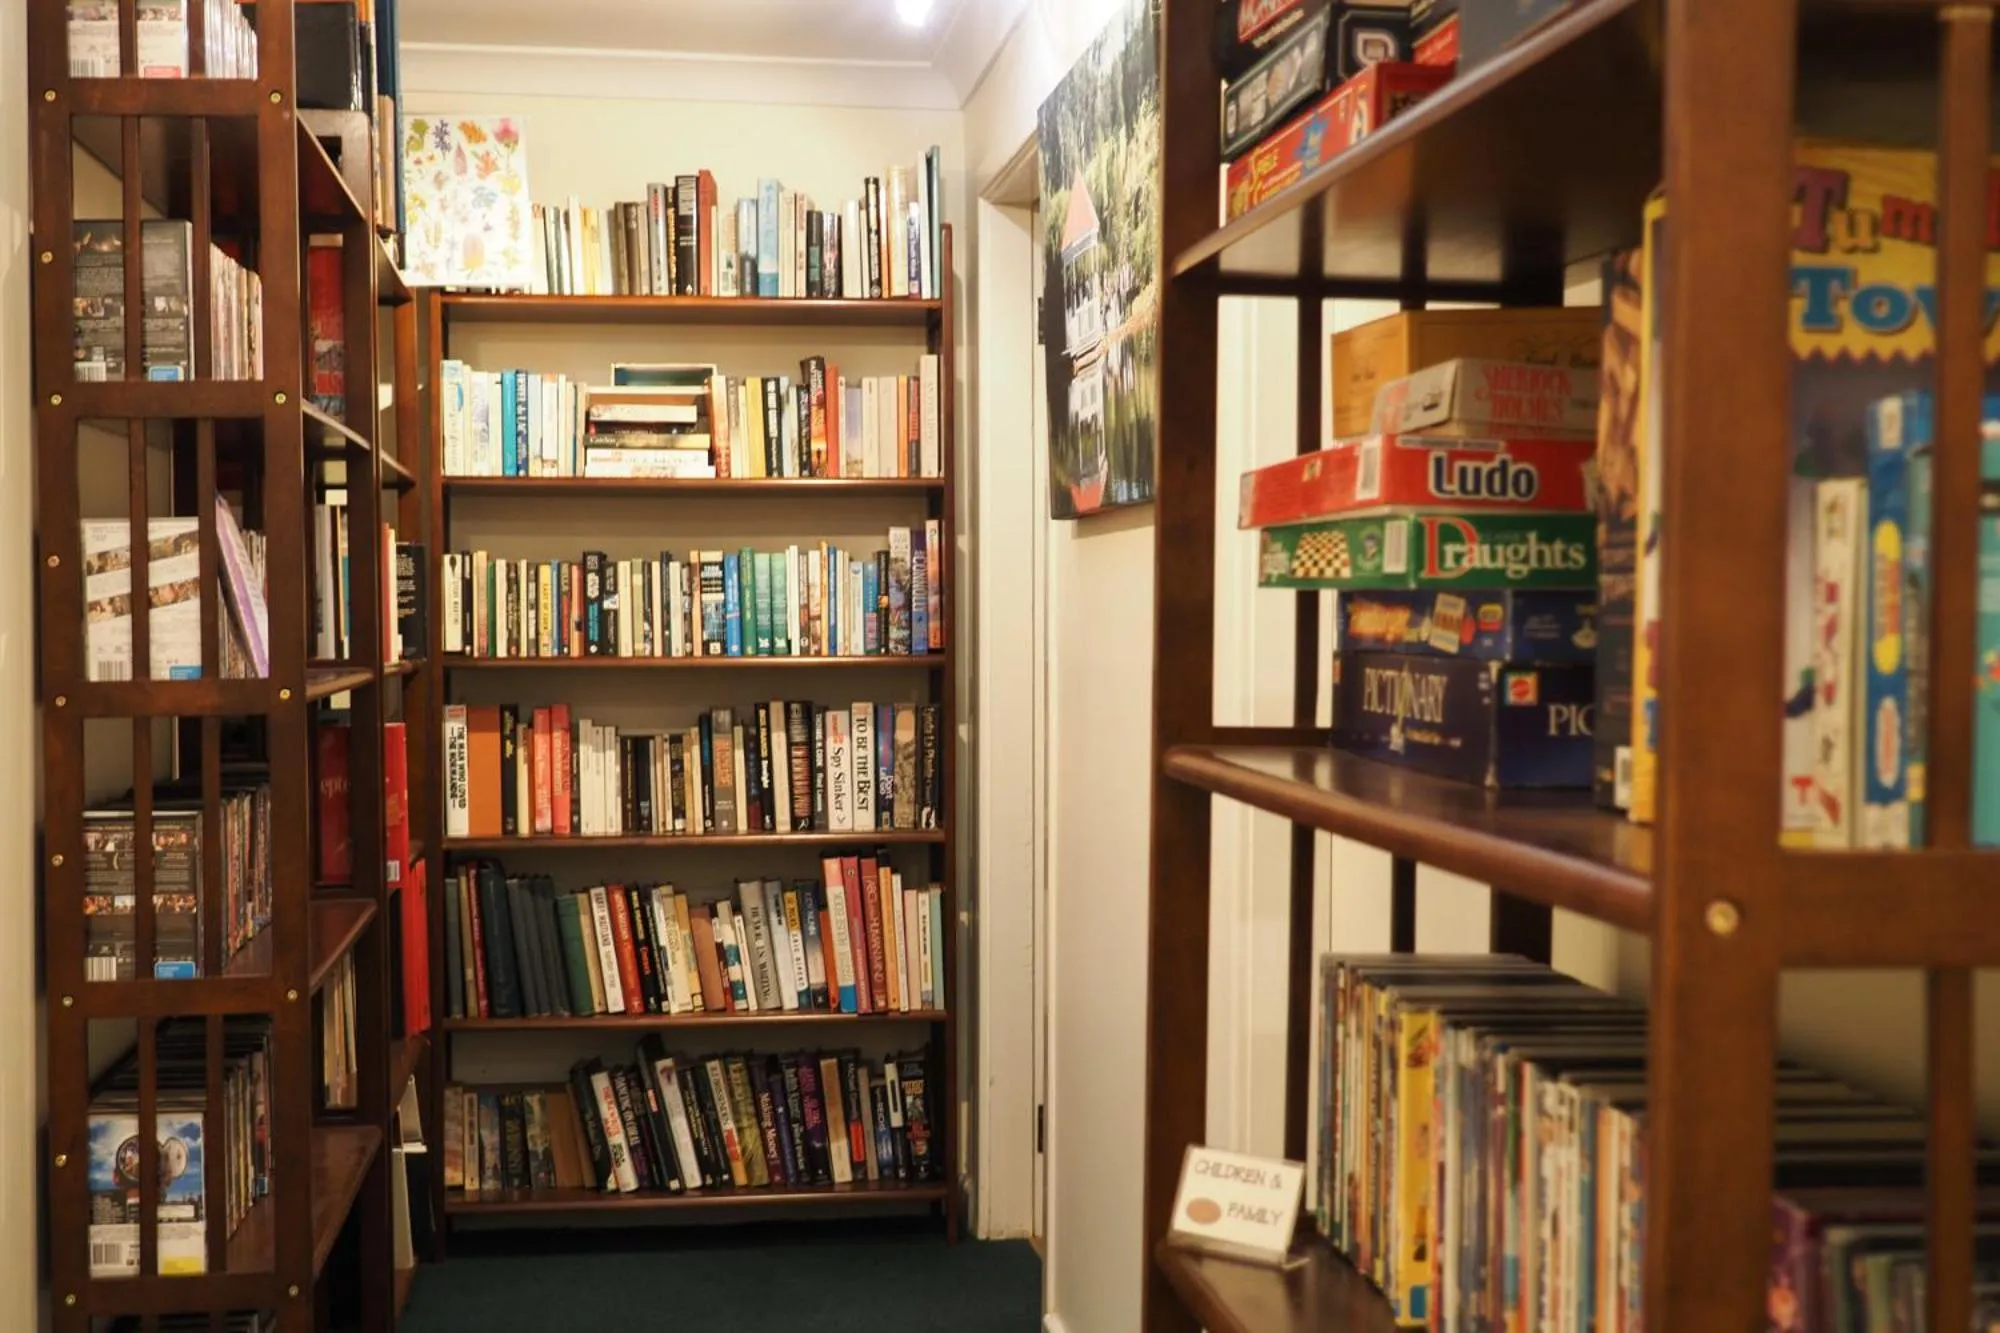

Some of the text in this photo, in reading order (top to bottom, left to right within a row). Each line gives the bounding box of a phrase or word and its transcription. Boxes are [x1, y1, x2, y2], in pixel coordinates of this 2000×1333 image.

[1428, 452, 1538, 502] Ludo
[1417, 517, 1587, 581] Draughts
[912, 555, 927, 612] CONNOLLY
[1362, 667, 1449, 723] PICTIONARY
[855, 716, 870, 733] TO
[458, 743, 466, 762] MAN
[855, 736, 869, 752] BE
[830, 747, 844, 768] Spy
[856, 754, 869, 775] THE
[458, 764, 466, 782] WHO
[458, 784, 466, 809] LOVED
[834, 772, 846, 812] Sinker
[758, 1091, 778, 1159] Making Money
[1194, 1158, 1284, 1190] CHILDREN &
[1226, 1202, 1284, 1226] FAMILY
